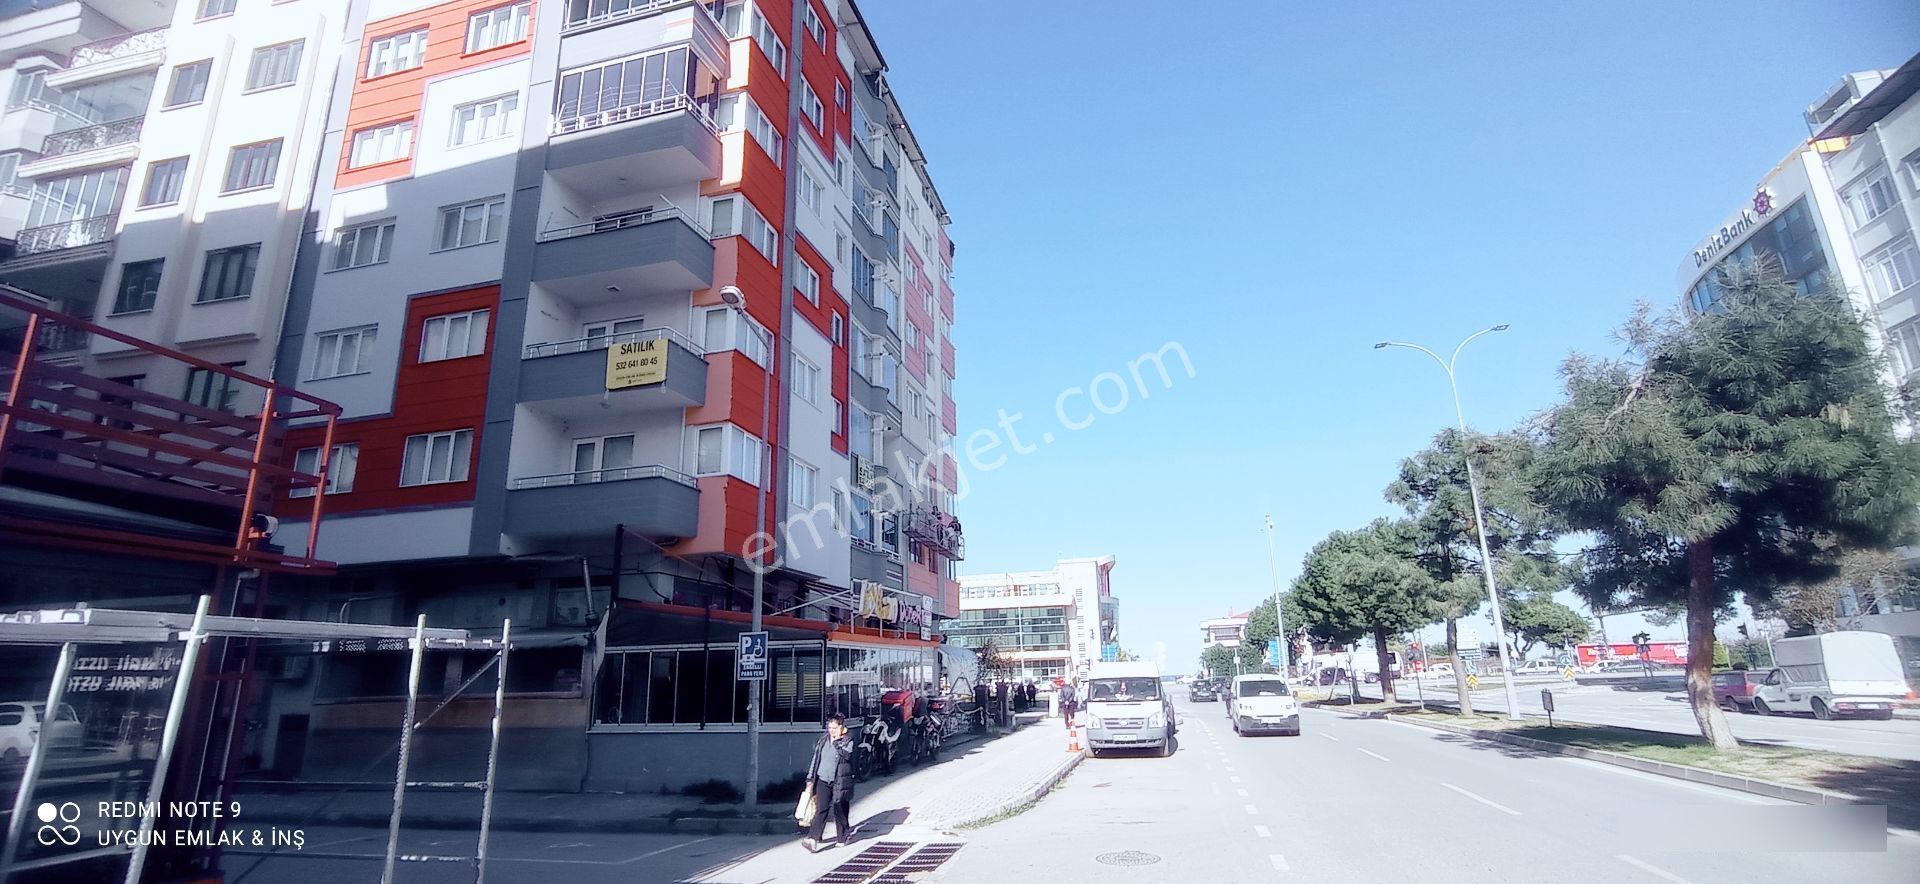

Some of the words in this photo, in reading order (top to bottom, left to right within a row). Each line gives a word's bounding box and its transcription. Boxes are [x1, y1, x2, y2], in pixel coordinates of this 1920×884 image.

[1693, 210, 1754, 268] DenizBank
[620, 340, 655, 355] SATILIK
[616, 361, 627, 371] 532
[650, 356, 658, 365] 45
[742, 636, 751, 654] P
